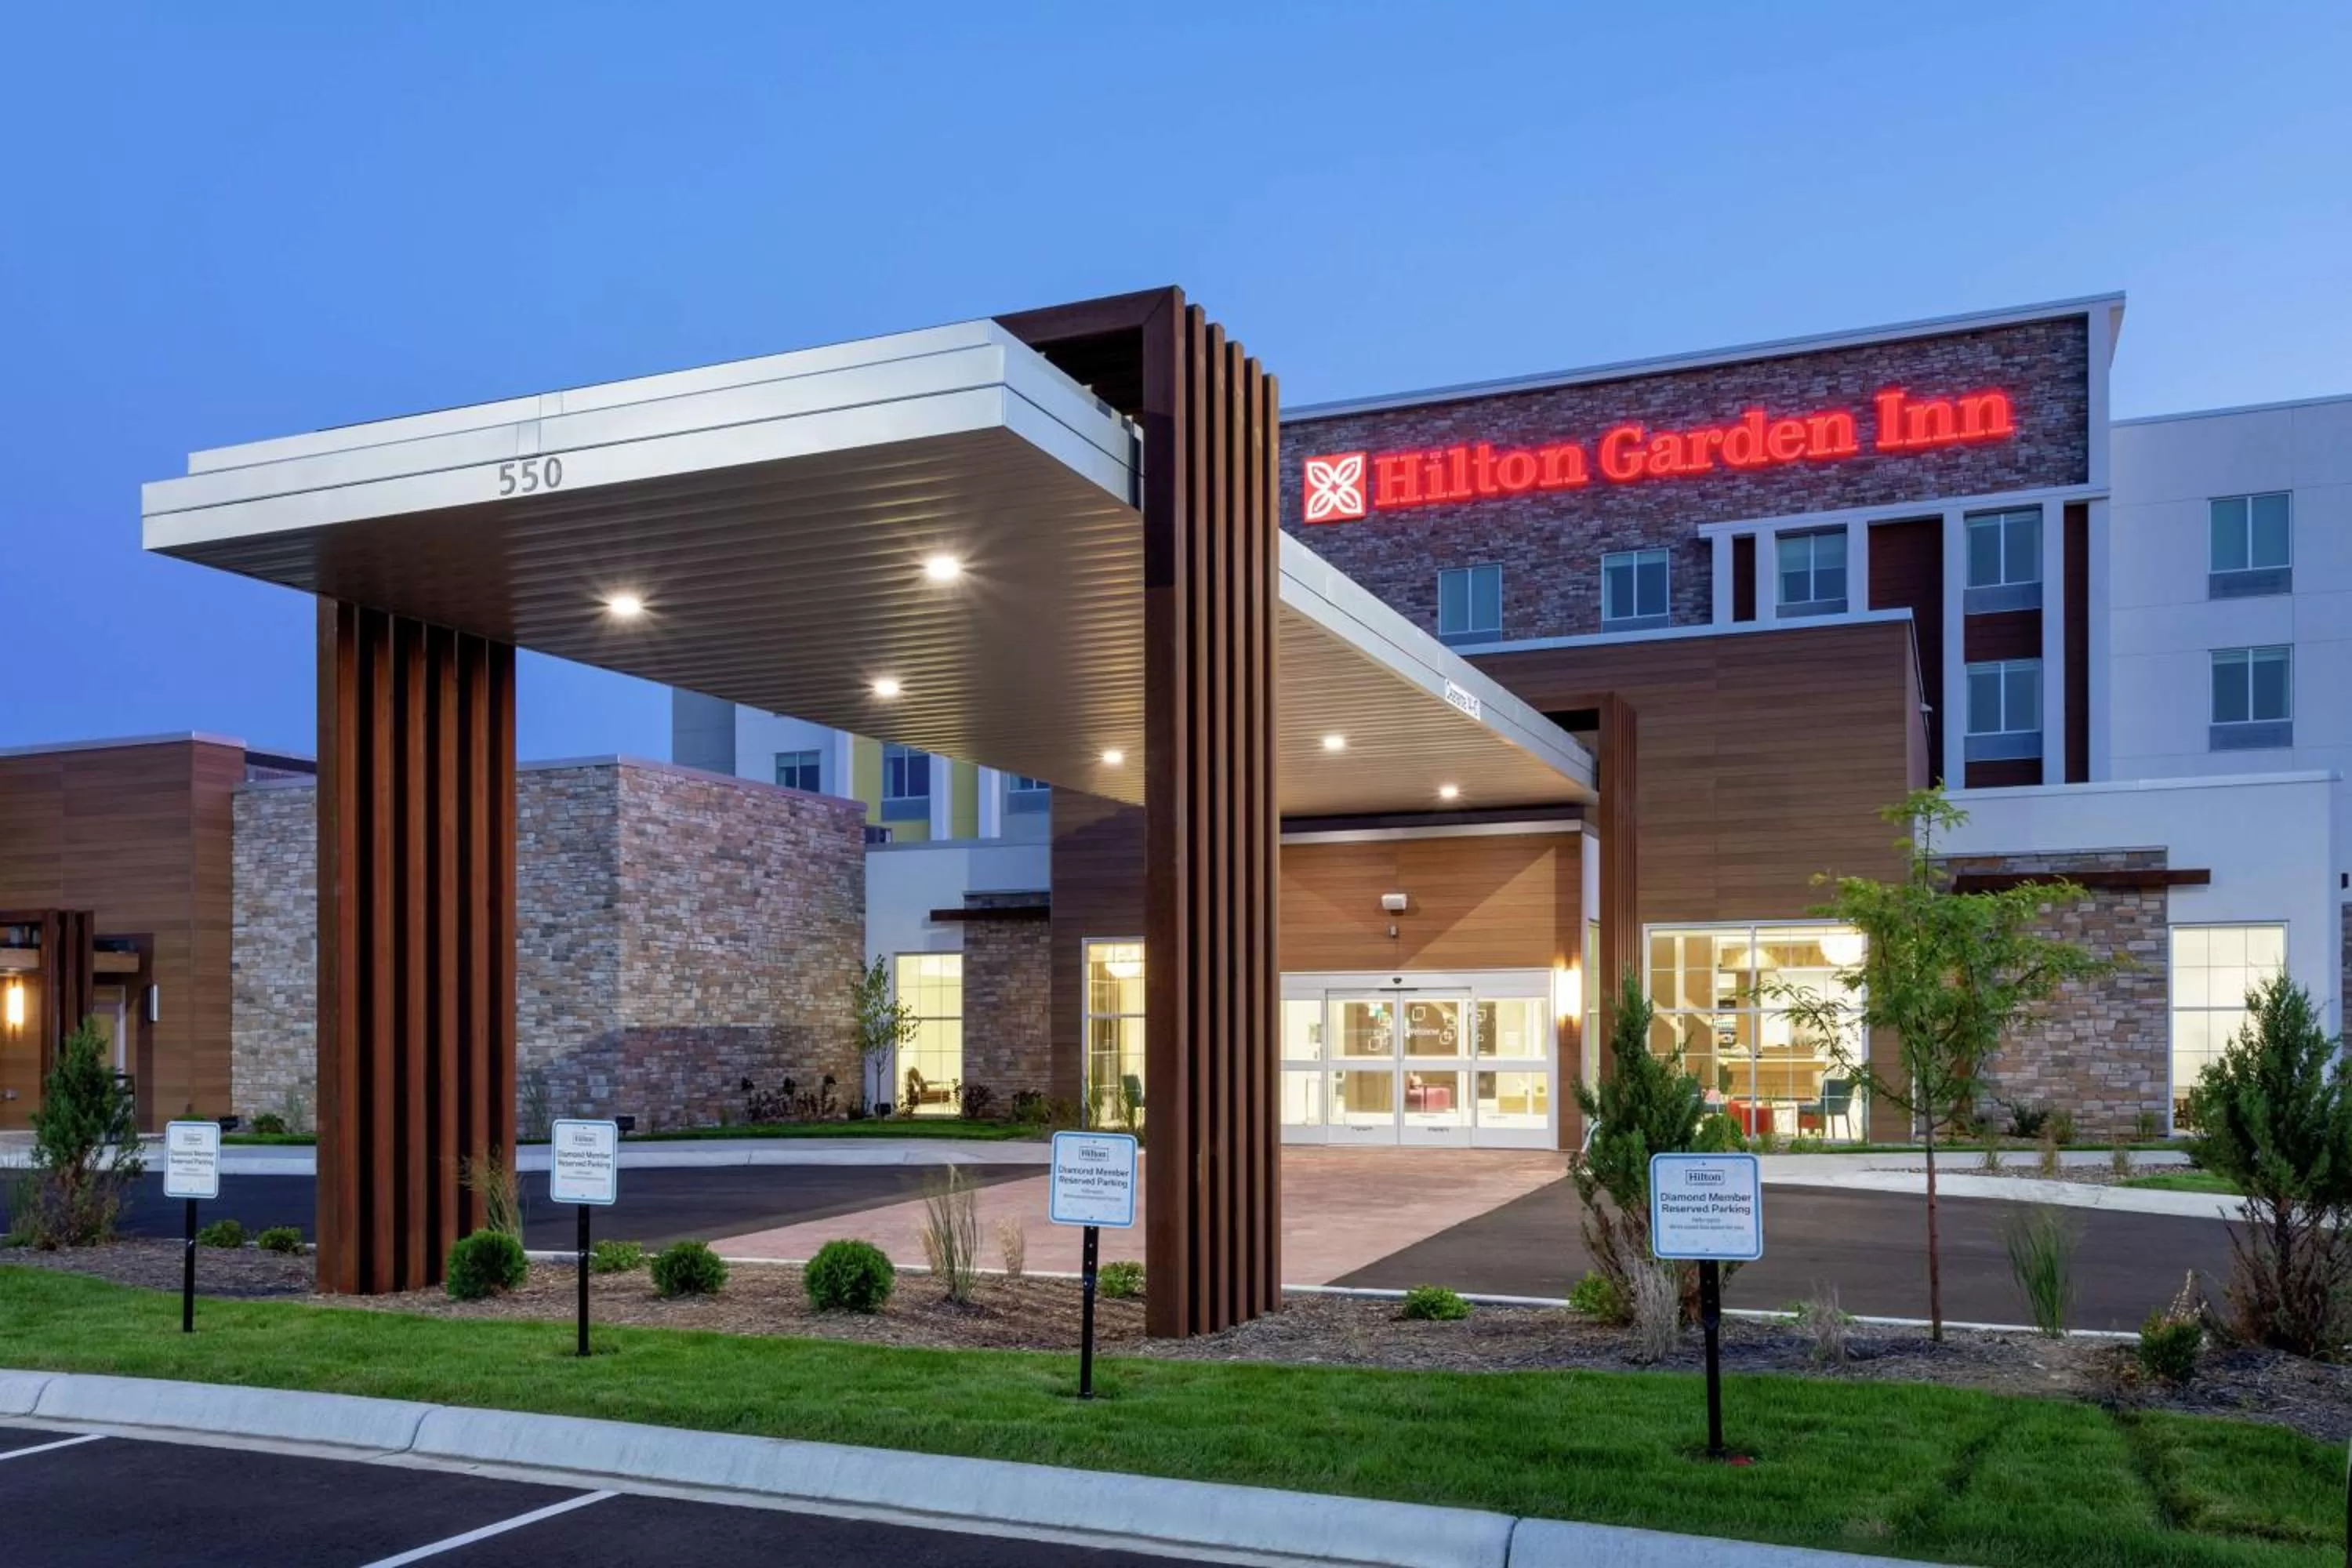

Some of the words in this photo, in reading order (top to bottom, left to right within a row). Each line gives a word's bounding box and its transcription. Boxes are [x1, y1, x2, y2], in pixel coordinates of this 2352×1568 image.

[1374, 444, 1588, 506] Hilton
[1600, 410, 1859, 479] Garden
[1875, 392, 2013, 448] Inn
[499, 457, 562, 495] 550
[1058, 1165, 1094, 1175] Diamond
[1096, 1167, 1130, 1177] Member
[1689, 1172, 1722, 1181] Hilton
[1059, 1176, 1095, 1186] Reserved
[1098, 1178, 1128, 1189] Parking
[1660, 1192, 1706, 1202] Diamond
[1708, 1192, 1751, 1203] Member
[1661, 1203, 1709, 1214] Reserved
[1711, 1204, 1751, 1215] Parking
